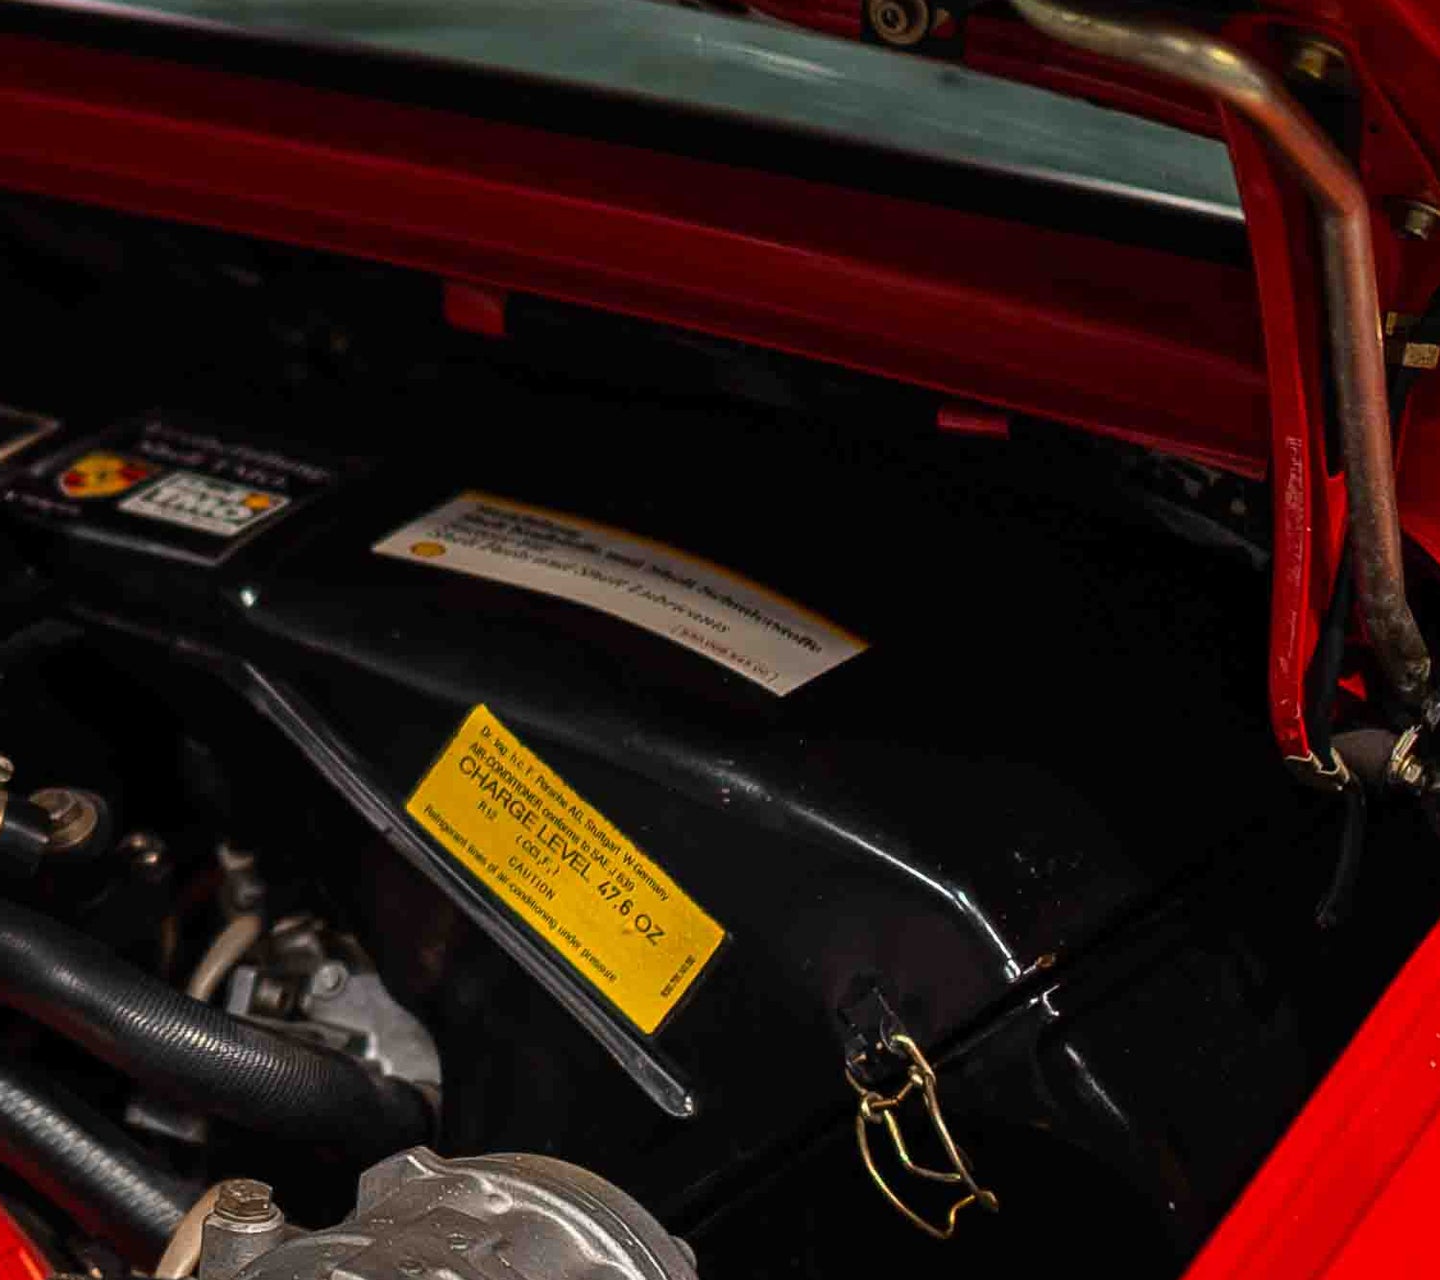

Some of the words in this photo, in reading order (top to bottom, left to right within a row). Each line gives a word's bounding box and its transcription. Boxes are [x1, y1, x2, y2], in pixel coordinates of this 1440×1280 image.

[457, 753, 540, 832] CHARGE
[533, 822, 592, 883] LEVEL
[533, 772, 569, 810] Porsche
[582, 817, 622, 856] Stuttgart
[540, 806, 581, 846] conforms
[506, 854, 556, 901] CAUTION
[555, 924, 582, 951] under
[578, 946, 617, 983] pressure
